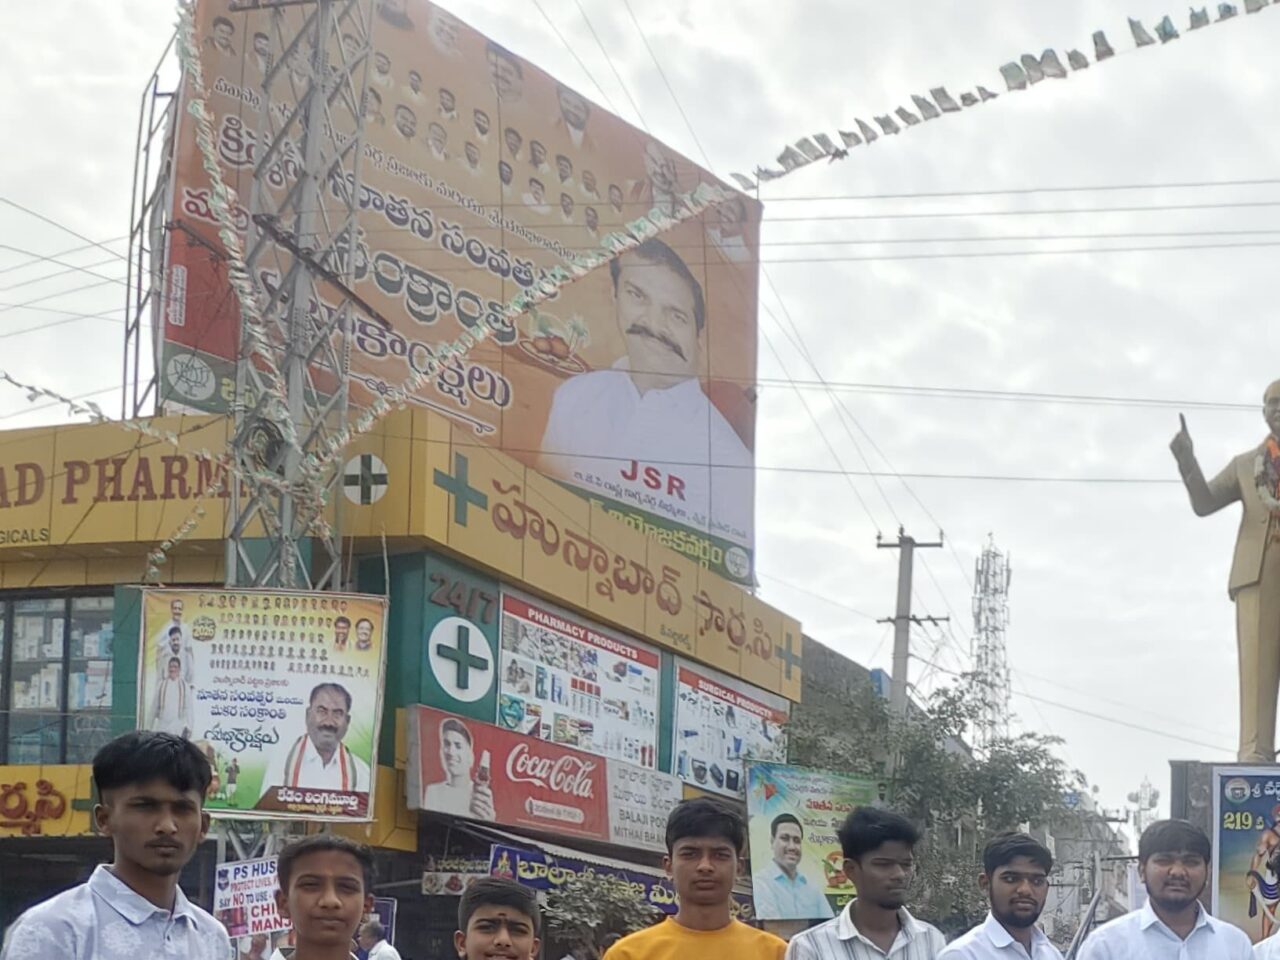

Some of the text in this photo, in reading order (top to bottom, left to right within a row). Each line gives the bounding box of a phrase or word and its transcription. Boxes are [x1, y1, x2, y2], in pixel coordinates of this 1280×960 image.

[620, 459, 686, 501] JSR
[491, 478, 682, 617] హుస్నాబాద్
[430, 572, 498, 624] 24/7
[527, 607, 639, 660] PHARMACY PRODUCTS
[211, 704, 237, 717] మకర
[619, 807, 649, 826] BALAJI
[1223, 811, 1254, 830] 219
[233, 865, 249, 880] PS
[218, 890, 269, 908] SAY NO TO USE
